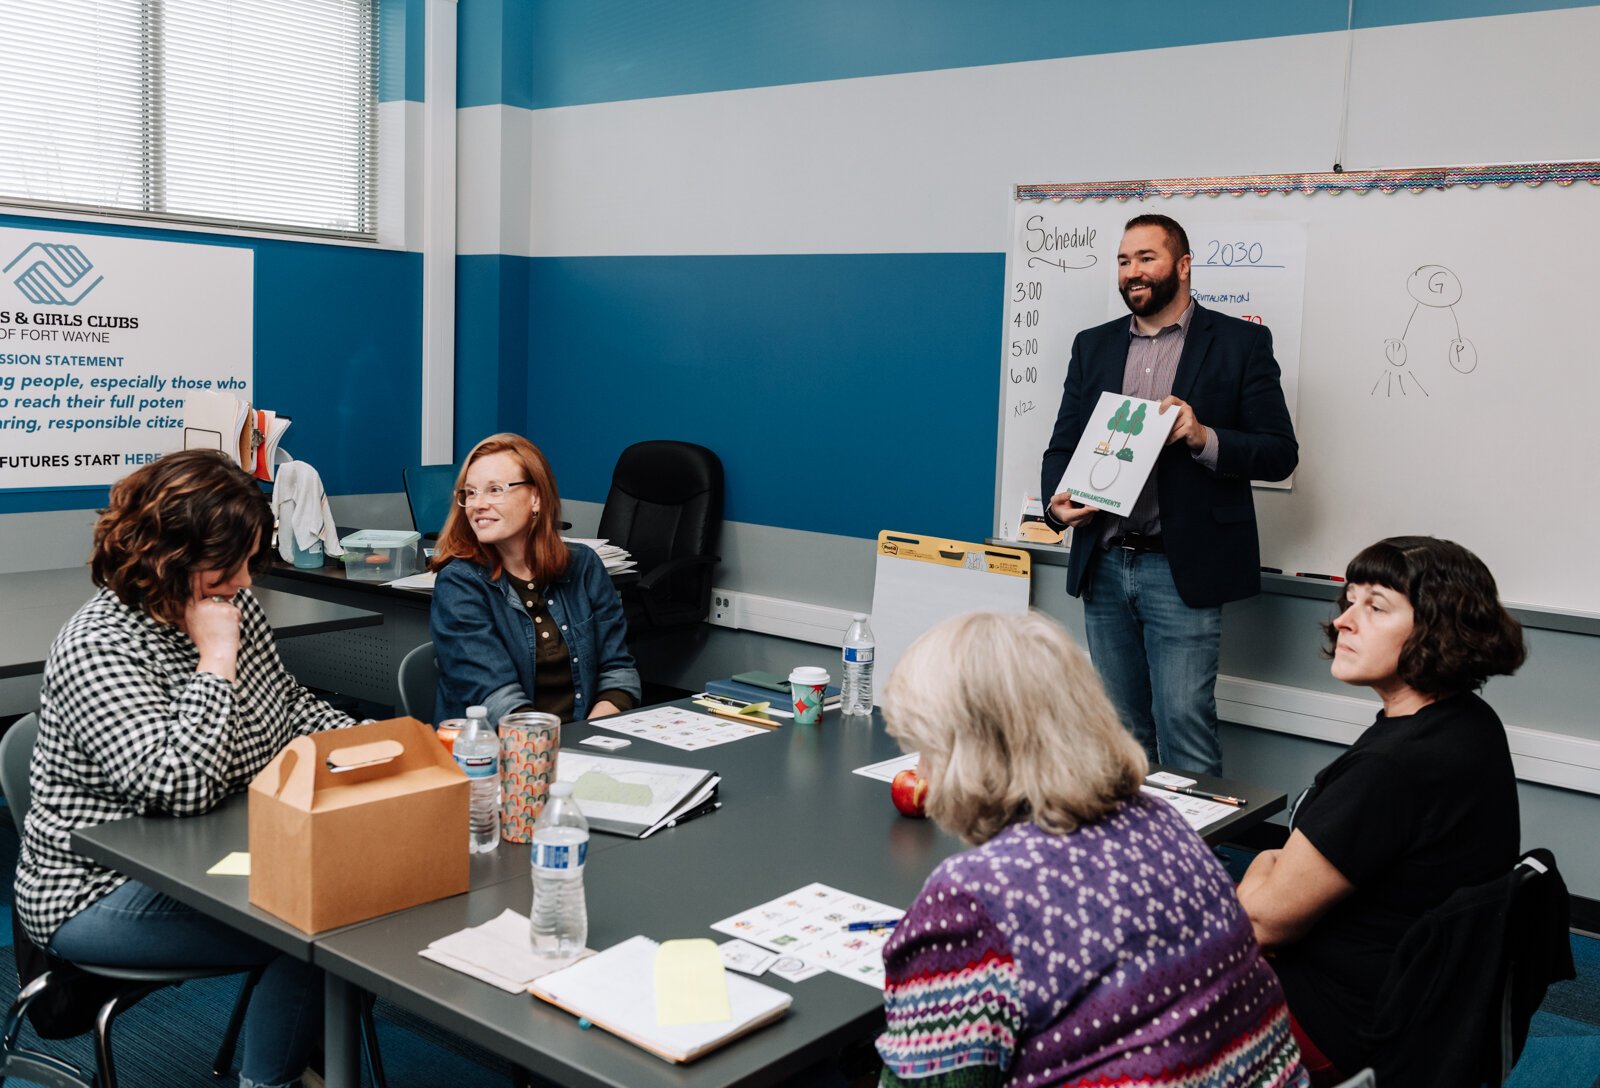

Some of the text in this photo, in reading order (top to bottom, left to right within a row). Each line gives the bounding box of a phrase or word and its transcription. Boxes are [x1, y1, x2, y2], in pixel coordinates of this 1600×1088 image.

[1026, 215, 1097, 253] Schedule
[1206, 239, 1263, 267] 2030
[1013, 281, 1042, 303] 3:00
[1428, 271, 1448, 294] G
[15, 311, 29, 325] &
[33, 312, 83, 327] GIRLS
[87, 315, 139, 329] CLUBS
[1013, 309, 1039, 328] 4:00
[21, 329, 59, 342] FORT
[62, 330, 110, 343] WAYNE
[1012, 338, 1038, 357] 5:00
[45, 355, 124, 367] STATEMENT
[20, 373, 84, 391] people,
[90, 374, 167, 393] especially
[171, 375, 212, 389] those
[217, 376, 247, 390] who
[1010, 366, 1037, 384] 6:00
[14, 394, 61, 409] reach
[66, 394, 105, 409] their
[109, 394, 135, 409] full
[139, 396, 186, 412] poten
[0, 415, 42, 433] ring,
[48, 414, 142, 432] responsible
[0, 455, 70, 468] FUTURES
[74, 454, 121, 467] START
[1080, 490, 1121, 509] ENHANCEMENTS
